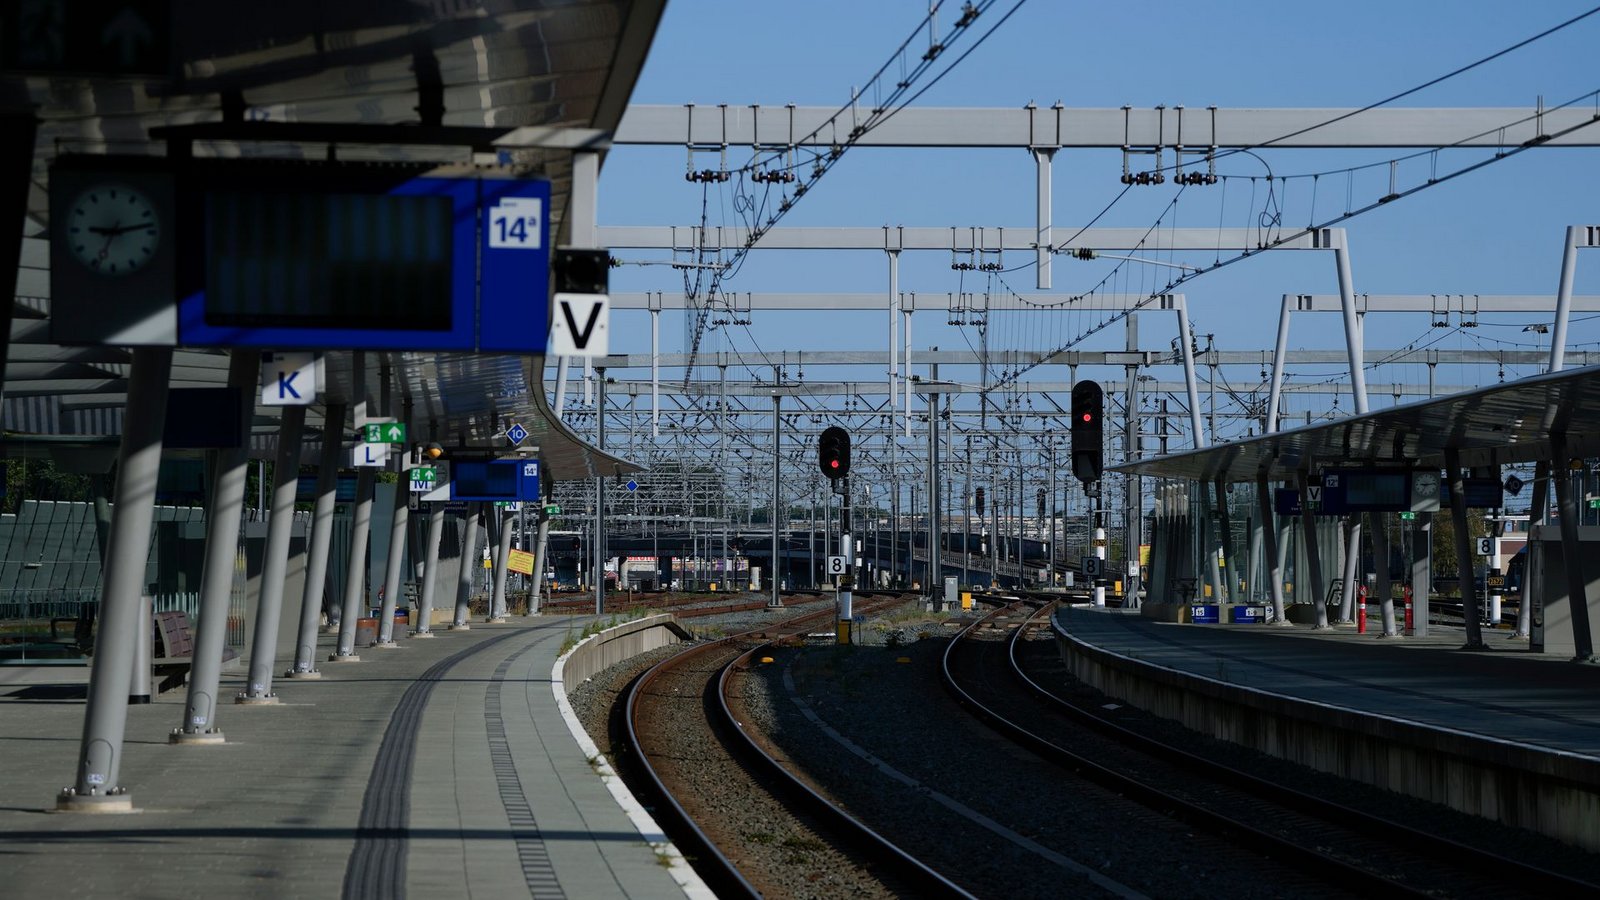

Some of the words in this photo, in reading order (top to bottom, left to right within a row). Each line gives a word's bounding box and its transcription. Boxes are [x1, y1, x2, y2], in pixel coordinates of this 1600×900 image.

[495, 216, 537, 243] 14a
[560, 301, 603, 349] V
[279, 371, 301, 399] K
[511, 429, 524, 439] 10
[366, 446, 376, 463] L
[1308, 487, 1320, 500] V
[508, 501, 517, 510] N
[1481, 539, 1490, 553] 8
[832, 558, 842, 572] 8
[1086, 559, 1096, 573] 8
